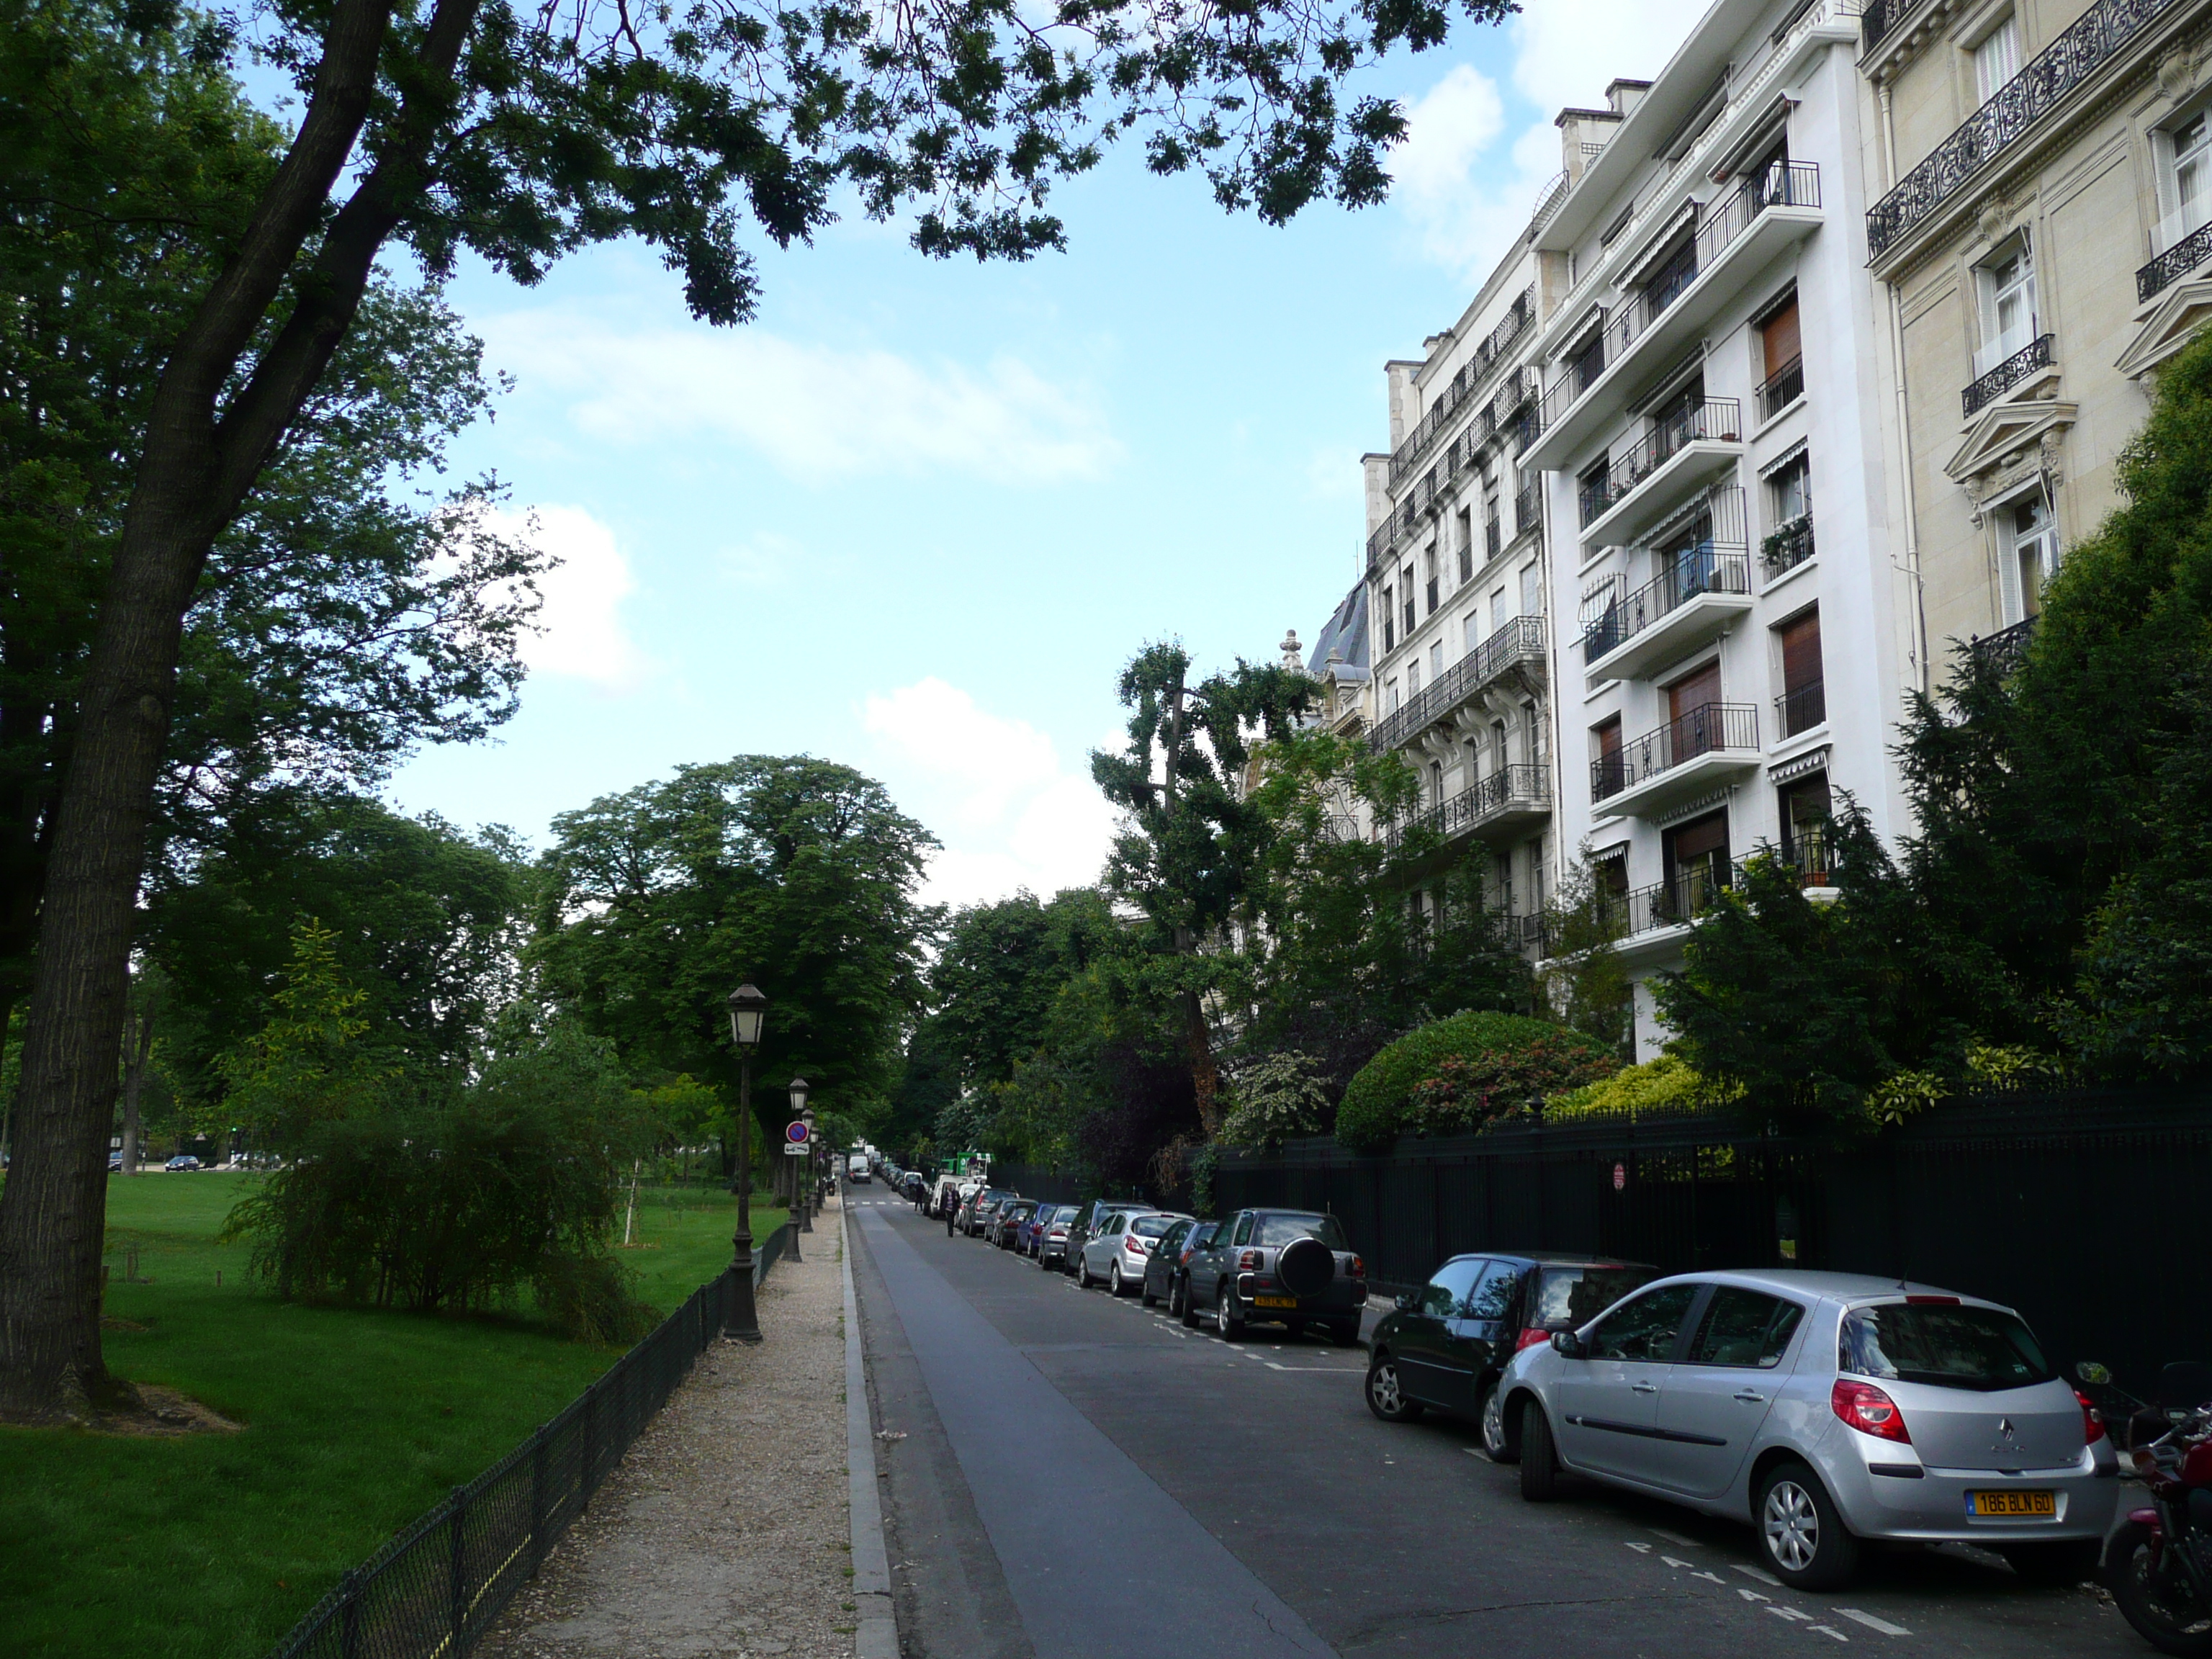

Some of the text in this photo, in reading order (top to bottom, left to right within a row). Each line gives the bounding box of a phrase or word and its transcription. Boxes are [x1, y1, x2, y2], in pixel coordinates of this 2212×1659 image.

[1981, 1494, 2050, 1512] 186 BLN 60
